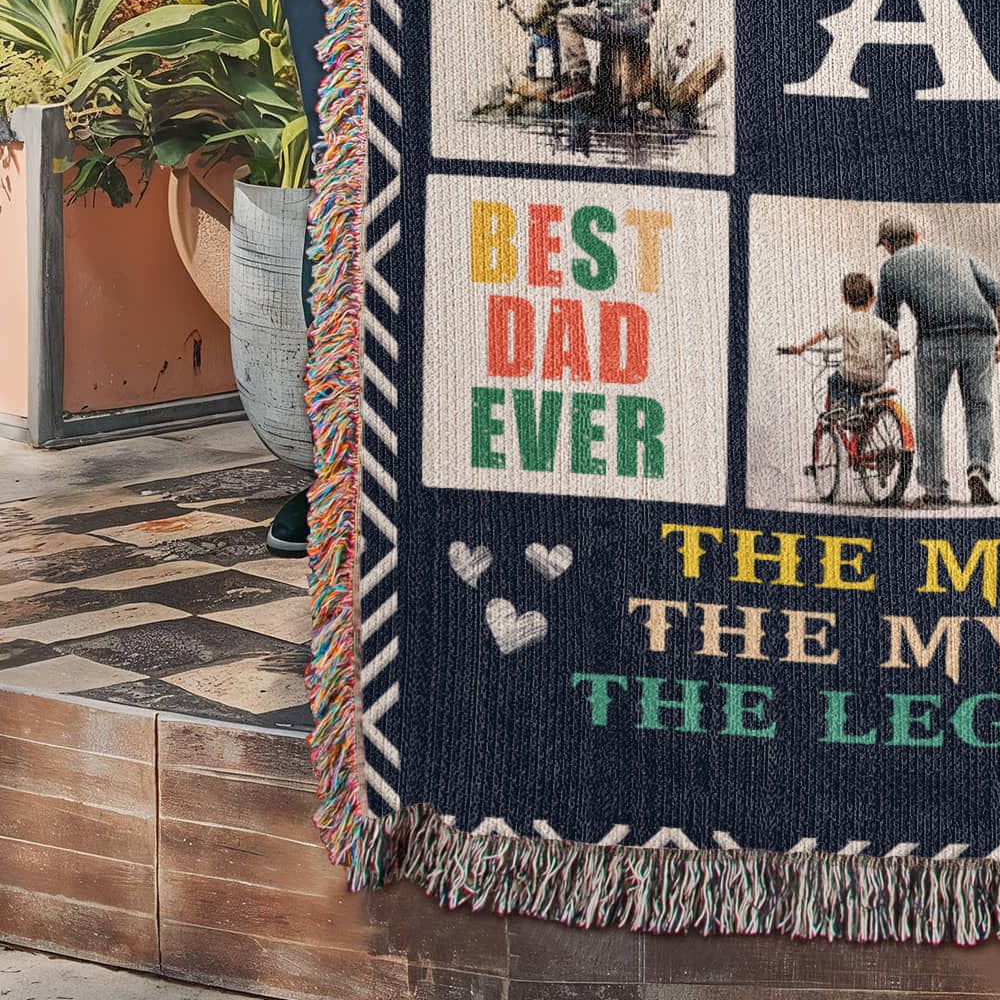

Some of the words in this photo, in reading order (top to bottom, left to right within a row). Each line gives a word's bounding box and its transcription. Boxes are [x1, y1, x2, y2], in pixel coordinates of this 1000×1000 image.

[470, 200, 672, 292] BEST
[487, 295, 649, 384] DAD
[470, 386, 665, 479] EVER
[661, 522, 876, 592] THE
[628, 597, 841, 667] THE
[571, 672, 777, 739] THE
